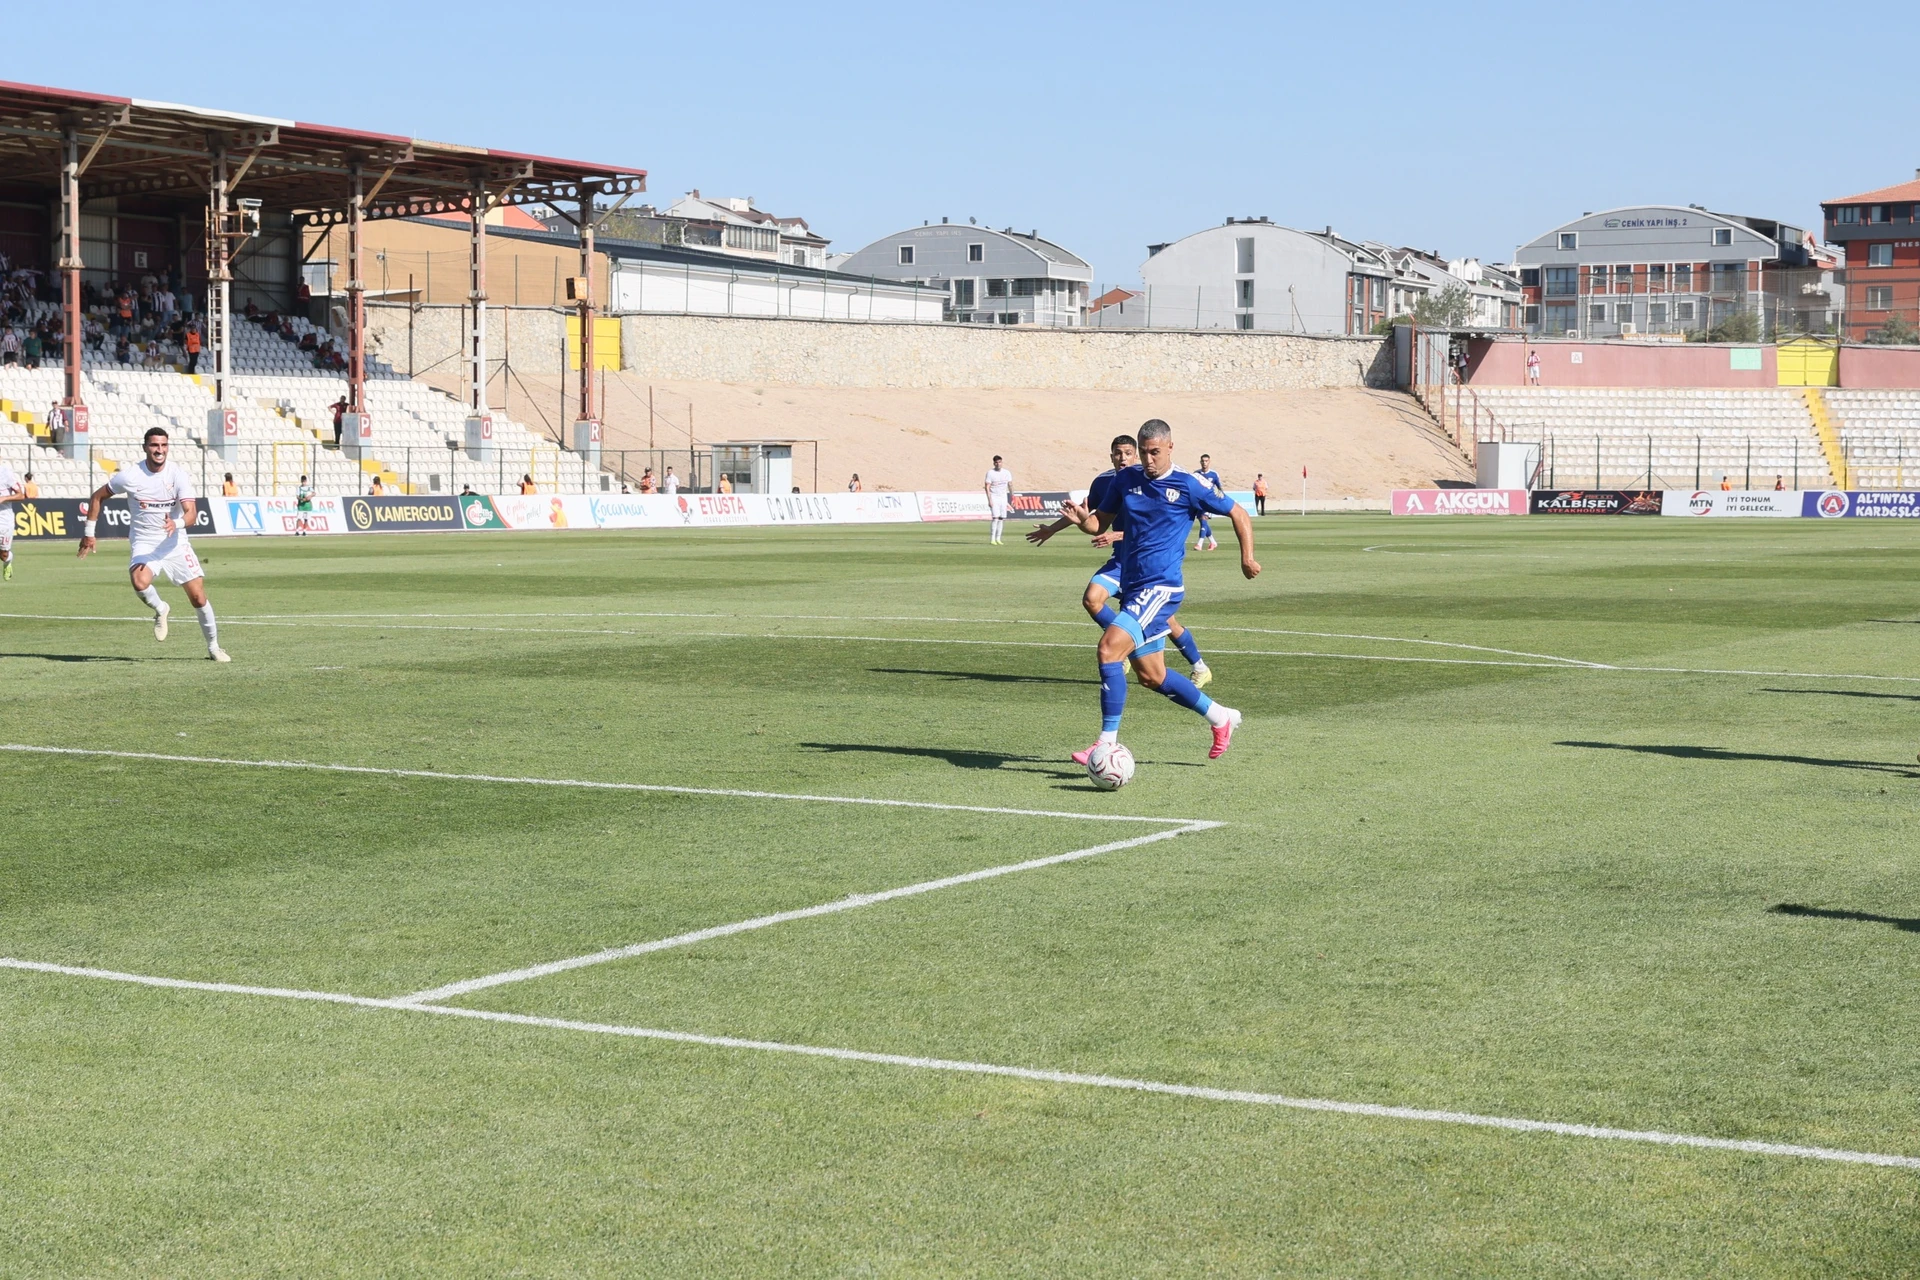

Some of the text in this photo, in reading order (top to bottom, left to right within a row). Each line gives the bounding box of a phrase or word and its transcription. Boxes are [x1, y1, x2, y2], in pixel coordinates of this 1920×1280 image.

[1621, 218, 1645, 227] CENİK
[1646, 218, 1663, 227] YAPI
[1682, 218, 1687, 226] 2
[227, 413, 236, 434] S
[361, 416, 370, 435] P
[591, 422, 600, 440] R
[699, 496, 747, 515] ETUSTA
[937, 501, 957, 513] SEDEF
[1537, 498, 1619, 509] KALBİŞEN
[1688, 499, 1714, 508] MTN
[1856, 492, 1916, 506] ALTINTAŞ
[374, 506, 454, 522] KAMERGOLD
[766, 497, 833, 521] COMPASS
